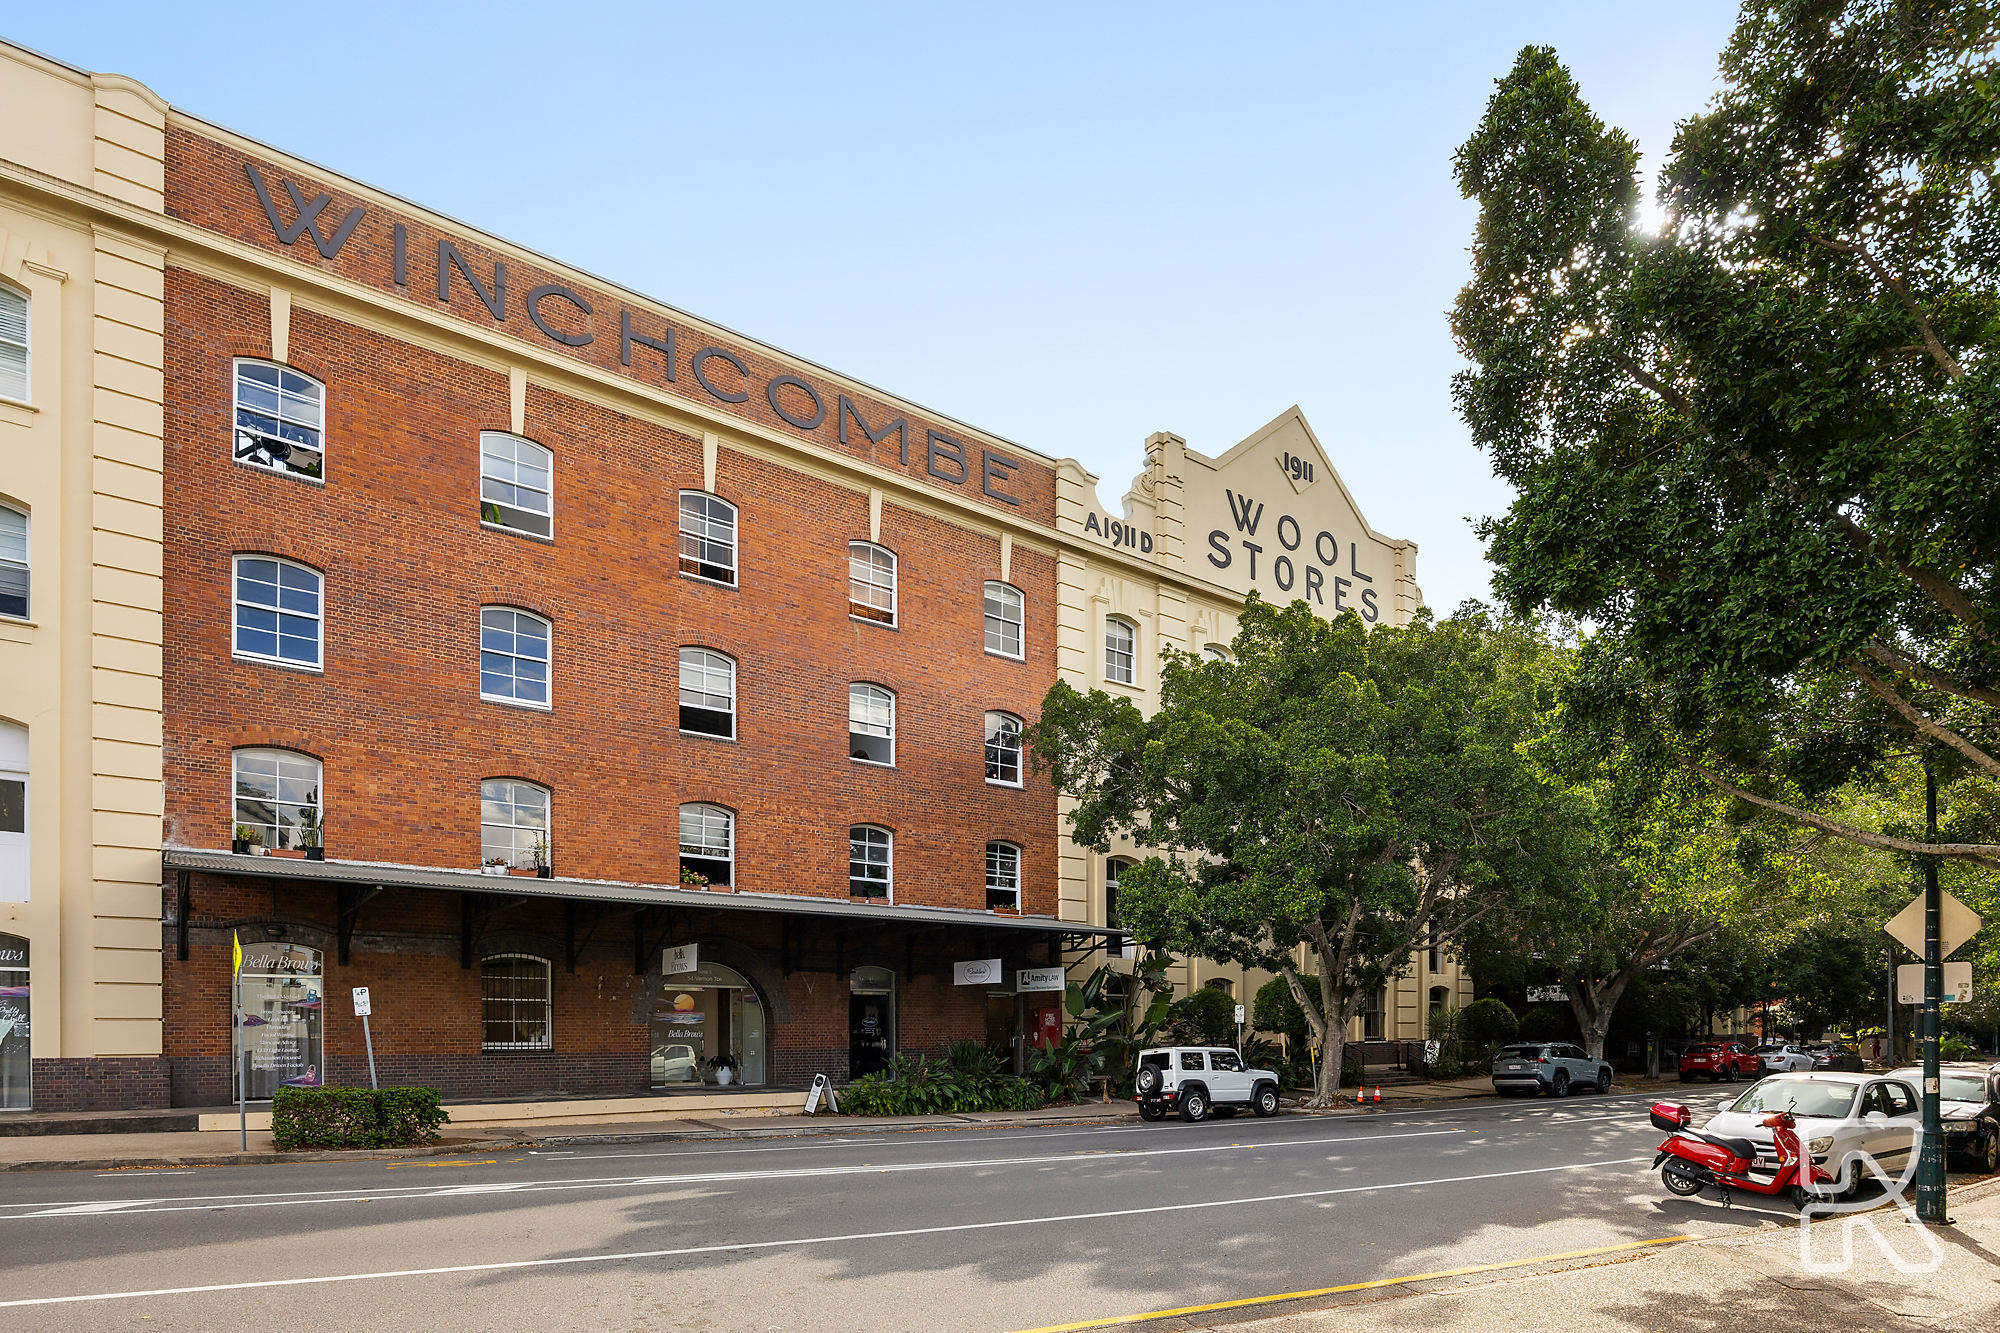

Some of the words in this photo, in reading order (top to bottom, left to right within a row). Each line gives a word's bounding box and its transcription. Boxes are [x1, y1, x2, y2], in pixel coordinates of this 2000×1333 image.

[244, 163, 1020, 506] WINCHCOMBE
[1284, 451, 1314, 483] 1911
[1226, 488, 1373, 583] WOOL
[1207, 529, 1379, 623] STORES
[240, 954, 276, 969] Bella
[277, 955, 319, 970] Brows
[1031, 974, 1048, 983] Amity
[668, 1029, 683, 1038] Bella
